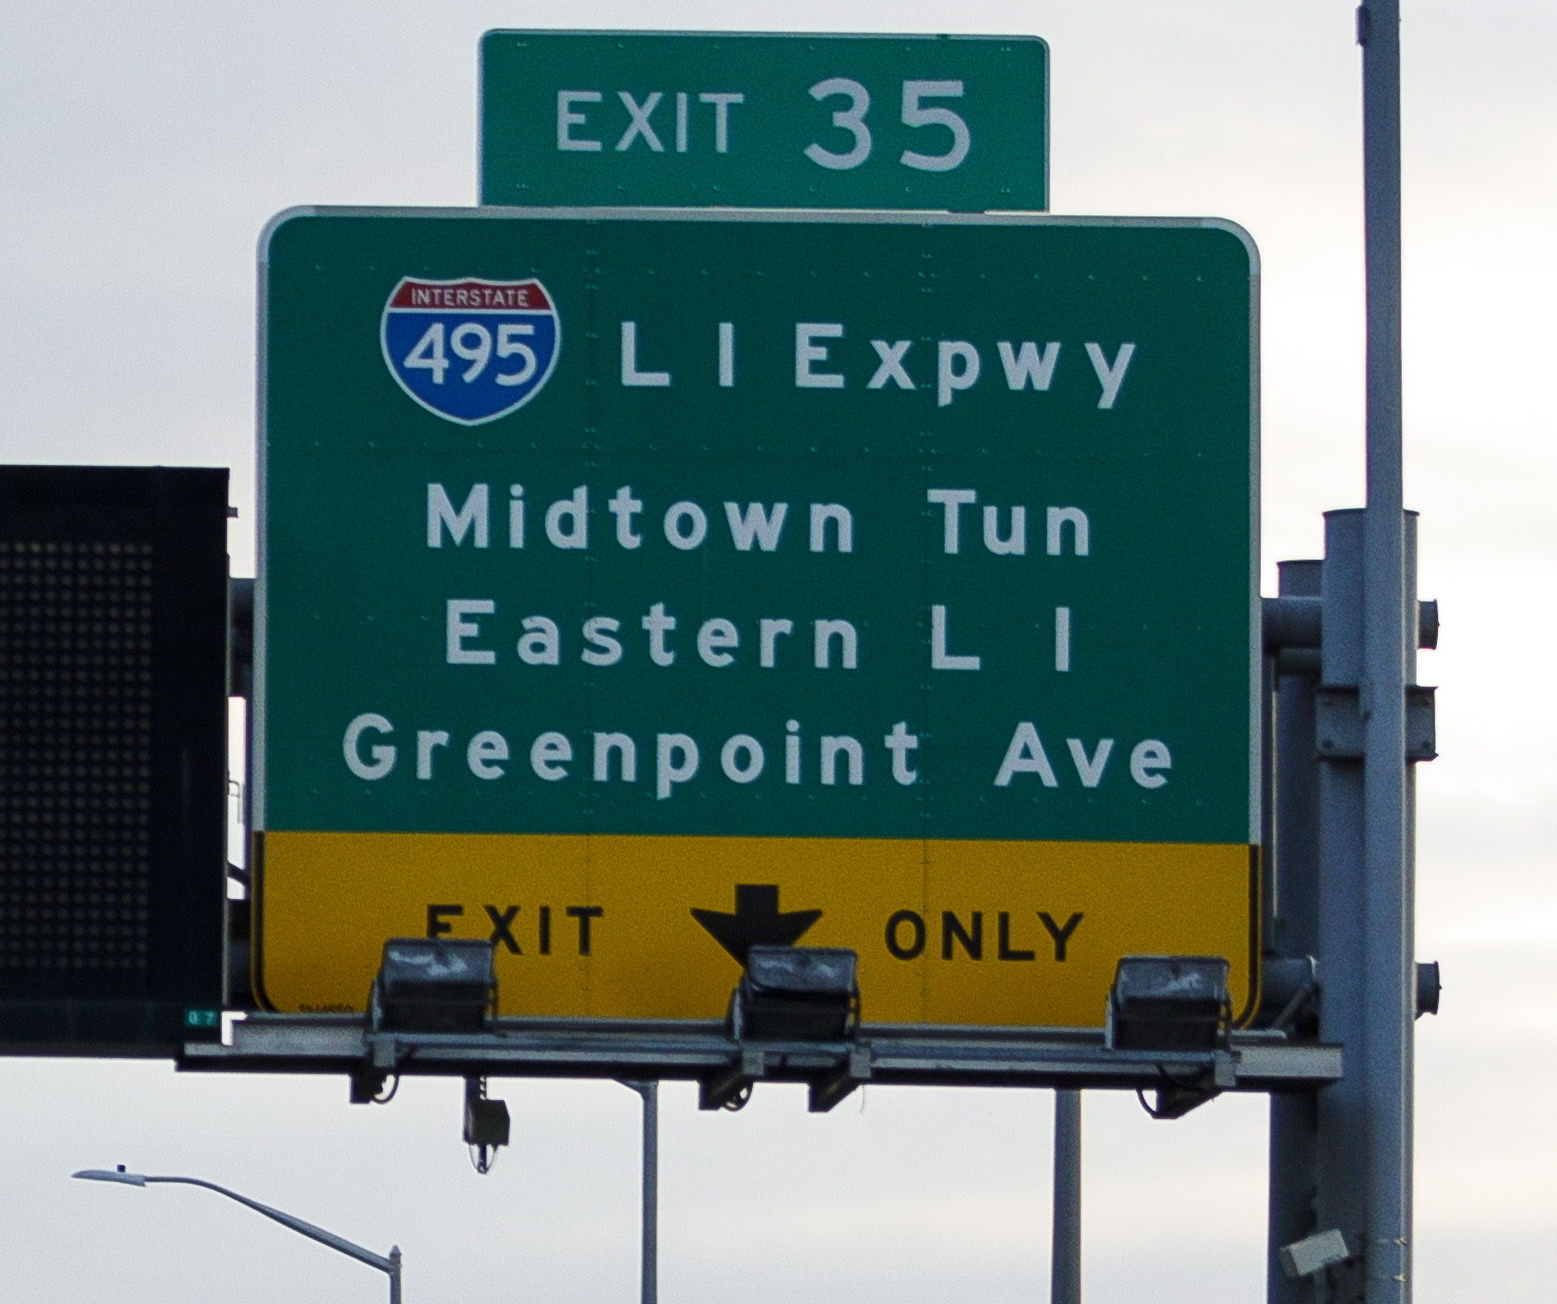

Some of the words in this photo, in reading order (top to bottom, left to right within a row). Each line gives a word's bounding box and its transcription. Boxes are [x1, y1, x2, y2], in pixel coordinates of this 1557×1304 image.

[557, 90, 745, 153] EXIT
[805, 77, 972, 172] 35
[411, 287, 530, 308] INTERSTATE
[403, 321, 537, 387] 495
[620, 321, 672, 388] L
[718, 322, 735, 387] I
[794, 322, 1137, 409] Expwy
[426, 482, 854, 553] Midtown
[927, 488, 1091, 556] Tun
[445, 598, 859, 670] Eastern
[931, 604, 982, 671] L
[1054, 606, 1071, 673] I
[342, 712, 920, 800] Greenpoint
[994, 721, 1173, 790] Ave
[427, 903, 605, 956] EXIT
[883, 907, 1086, 964] ONLY
